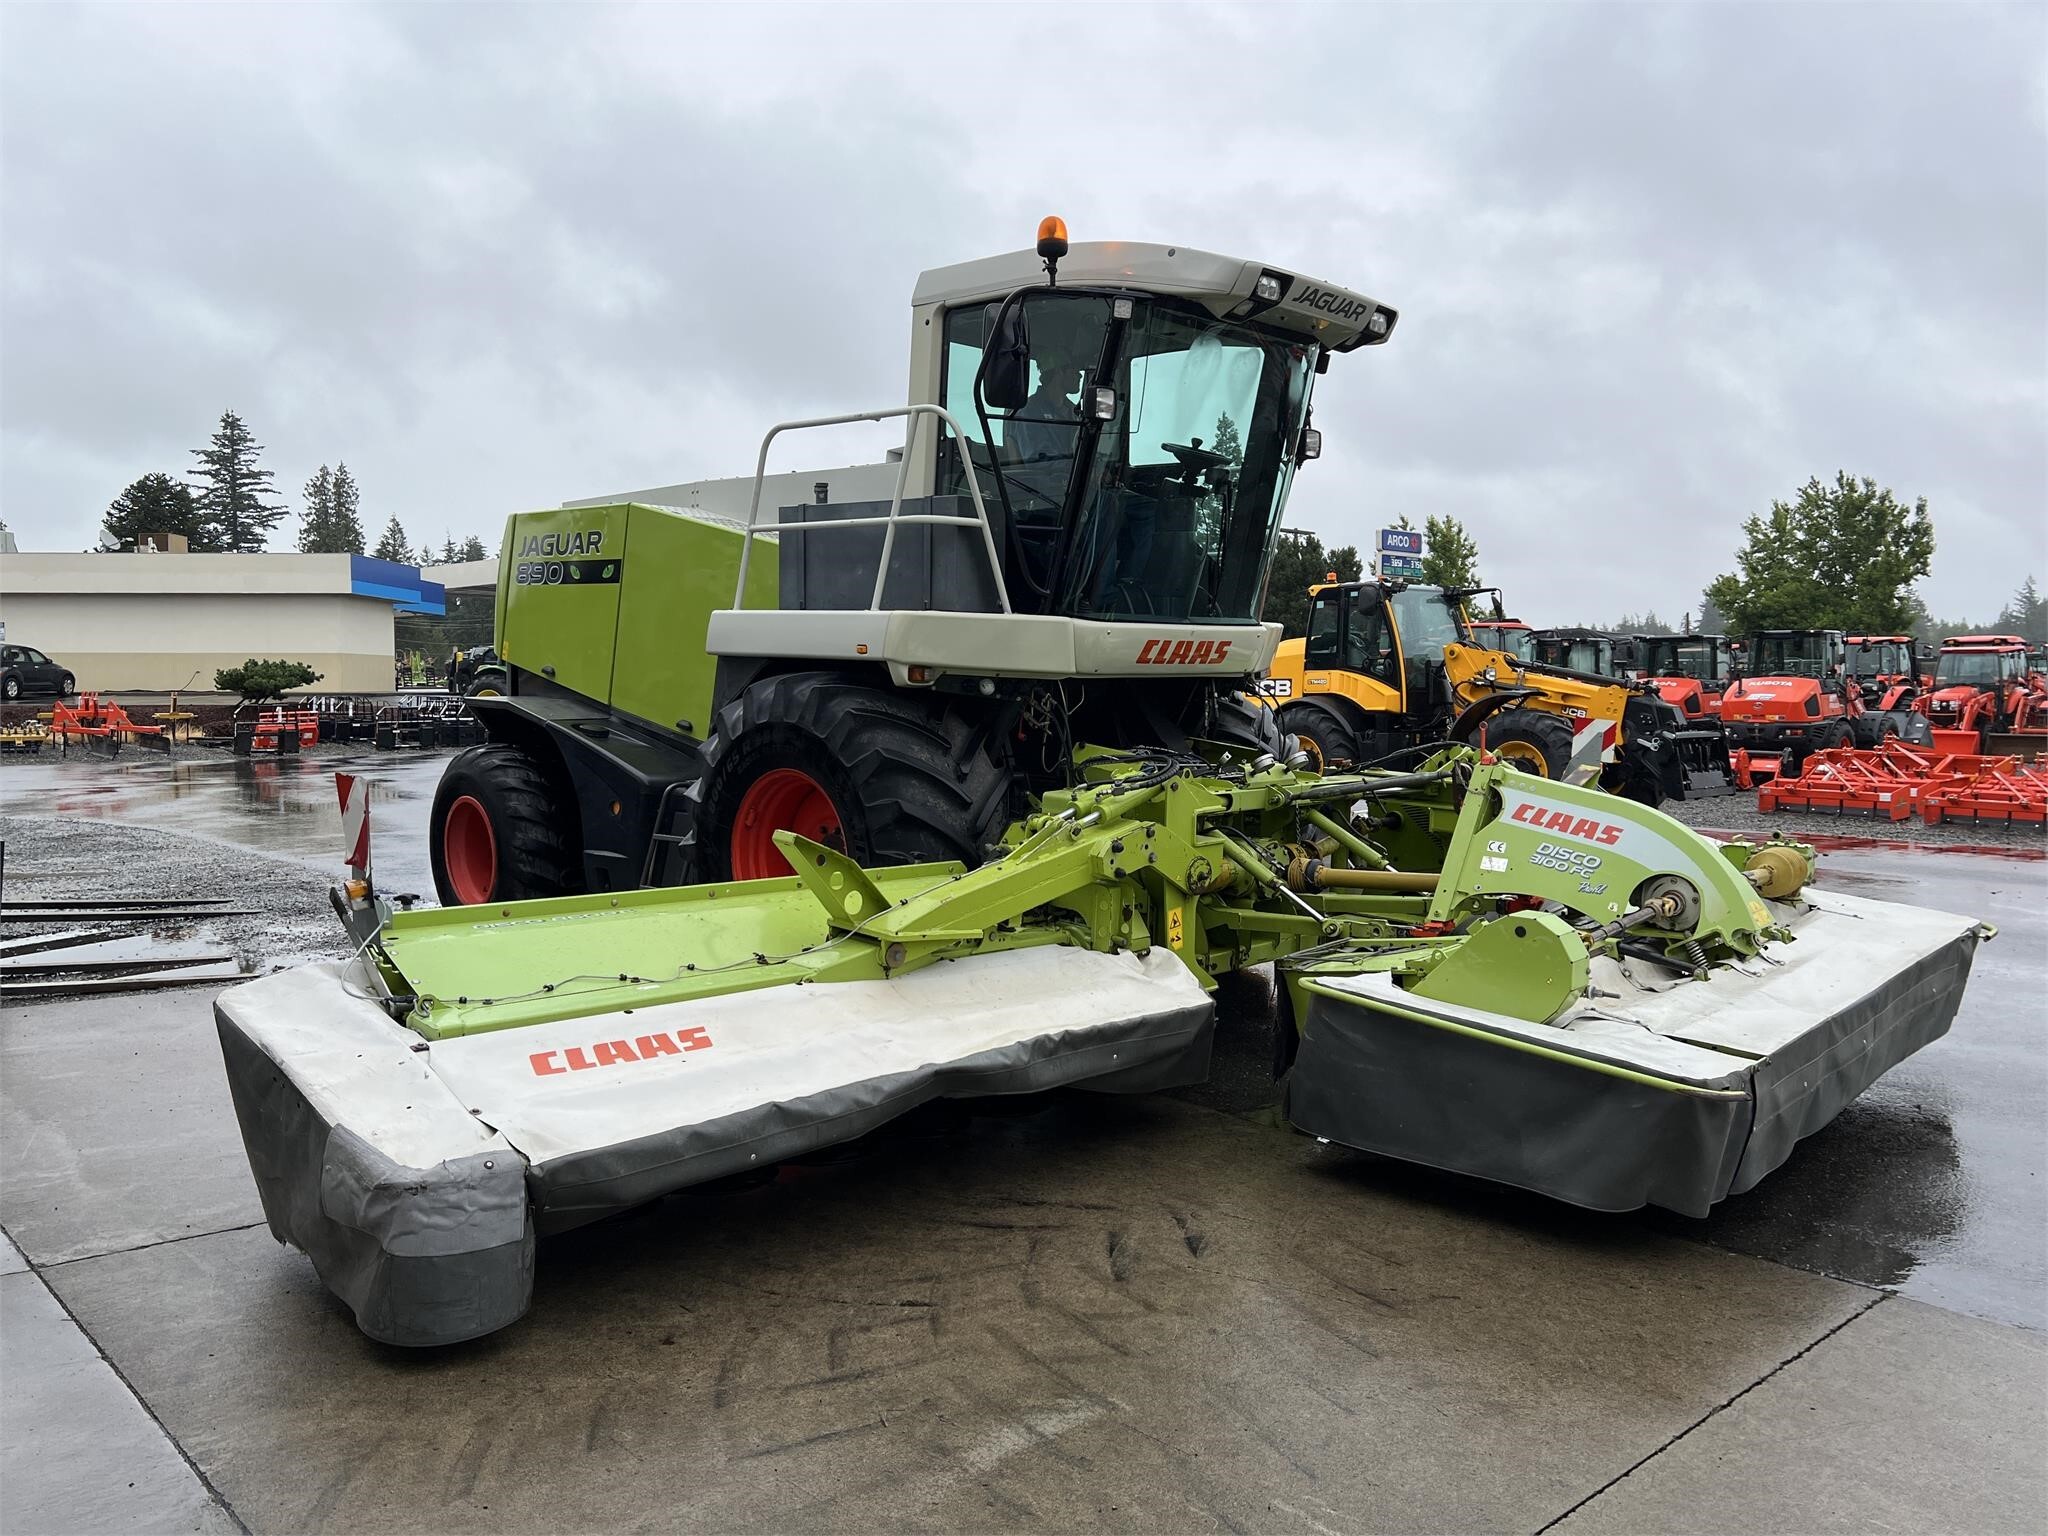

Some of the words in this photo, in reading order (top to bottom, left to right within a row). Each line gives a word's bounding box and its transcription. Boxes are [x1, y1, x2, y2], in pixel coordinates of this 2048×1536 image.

[1291, 285, 1368, 322] JAGUAR
[517, 530, 603, 558] JAGUAR
[1387, 534, 1410, 548] ARCO
[516, 560, 564, 586] 890
[1135, 639, 1233, 665] CLAAS
[1561, 706, 1587, 718] JCB
[1511, 803, 1624, 846] CLAAS
[1529, 853, 1569, 873] 3100
[1570, 863, 1595, 880] FC
[1535, 842, 1603, 870] DISCO
[529, 1025, 714, 1076] CLAAS
